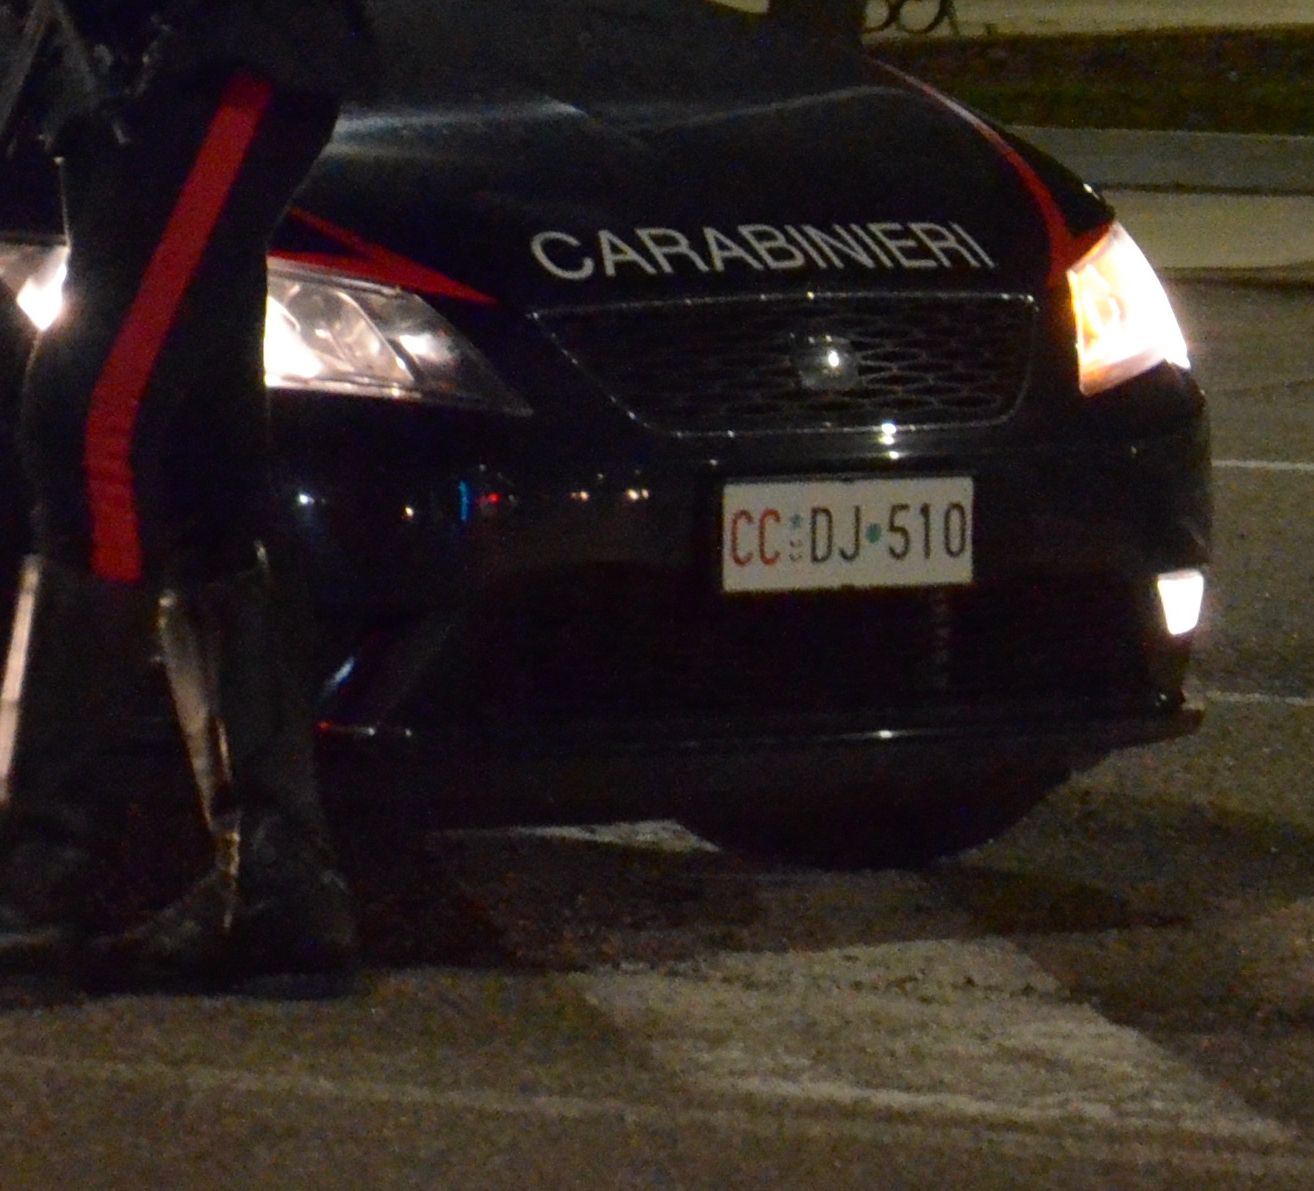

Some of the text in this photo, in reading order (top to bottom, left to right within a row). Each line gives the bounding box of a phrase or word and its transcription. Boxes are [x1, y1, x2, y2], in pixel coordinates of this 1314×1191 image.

[530, 220, 996, 281] CARABINIERI
[730, 501, 967, 567] CC DJ 510
